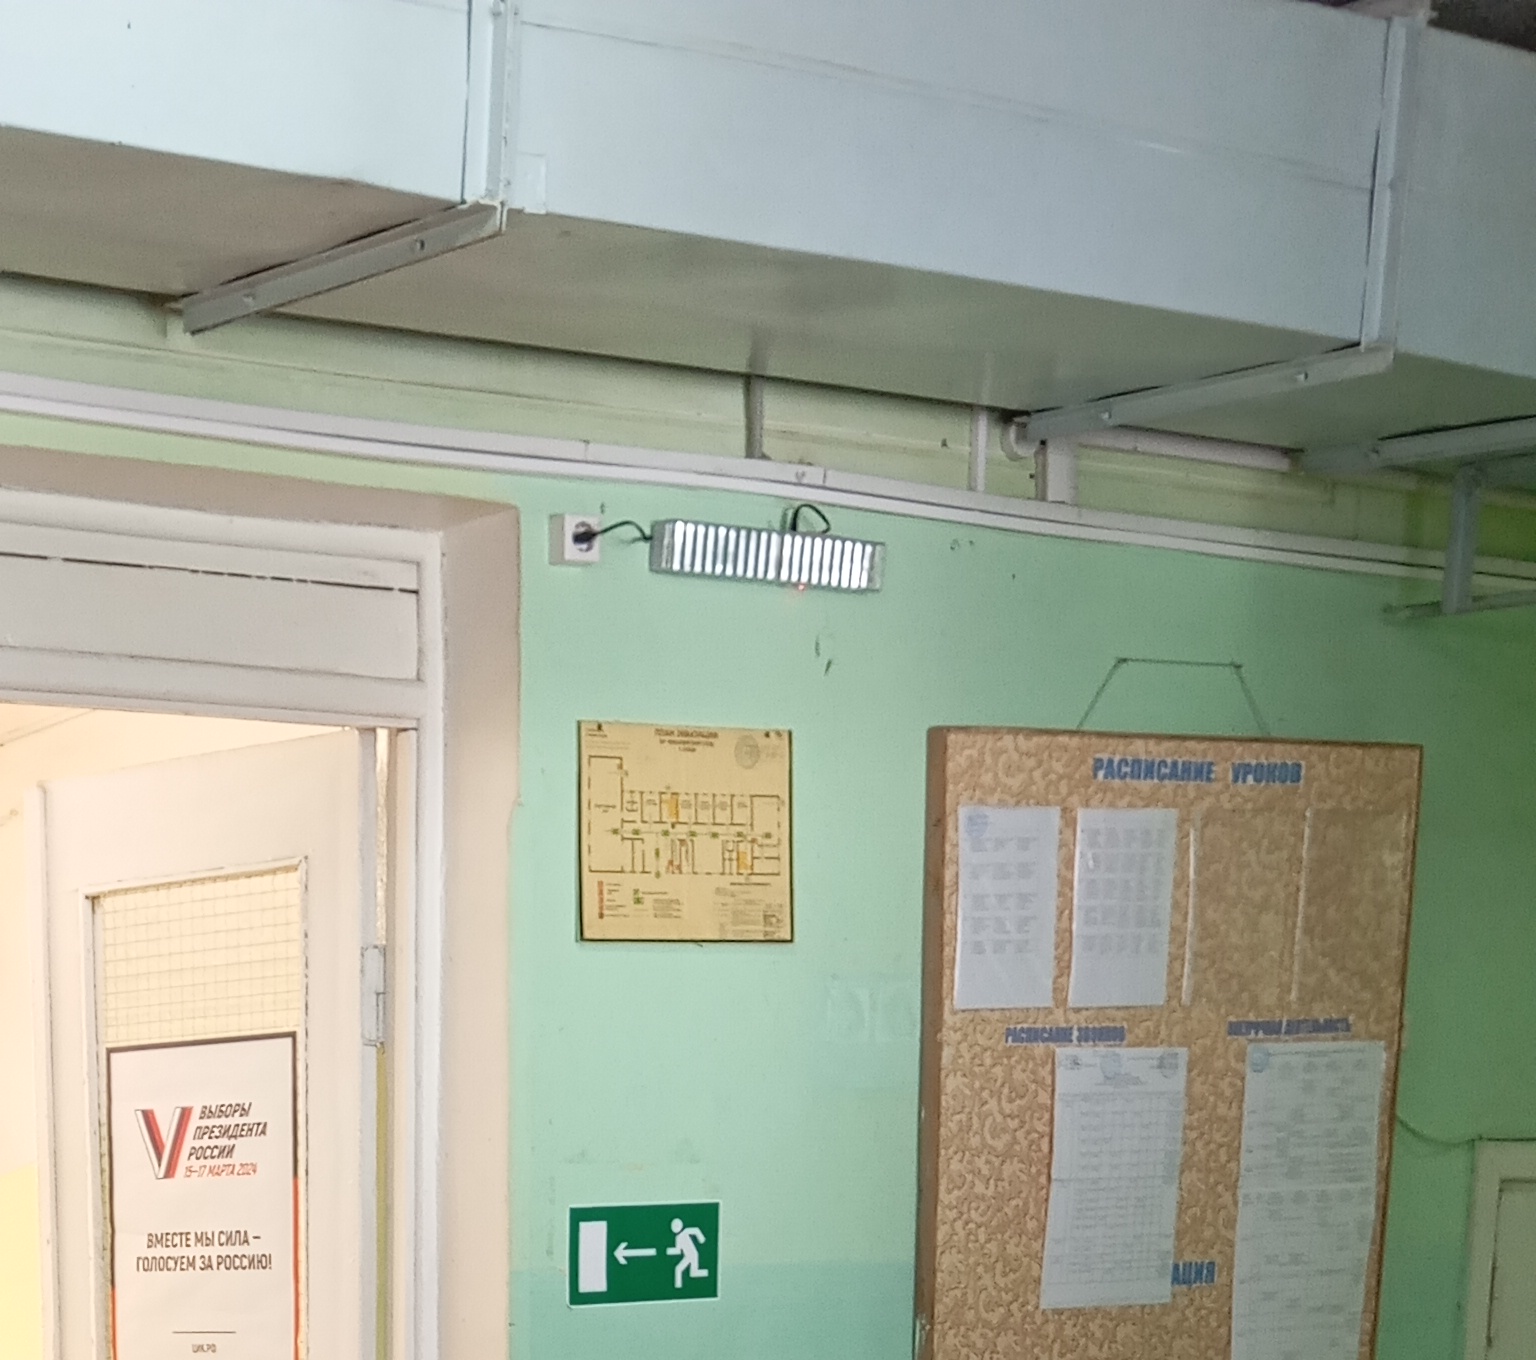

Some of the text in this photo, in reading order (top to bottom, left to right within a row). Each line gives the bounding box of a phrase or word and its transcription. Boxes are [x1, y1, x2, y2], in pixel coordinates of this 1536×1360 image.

[1093, 757, 1303, 785] РАСПИСАНИЕ УРОКОВ
[199, 1102, 252, 1120] ВЫБОРЫ
[193, 1122, 267, 1141] ПРЕЗИДЕНТА
[187, 1144, 236, 1161] РОССИИ
[208, 1163, 236, 1177] МАРТА
[236, 1162, 258, 1176] 2024
[147, 1231, 191, 1249] ВМЕСТЕ
[194, 1230, 214, 1247] МЫ
[217, 1230, 250, 1247] СИЛА
[136, 1253, 272, 1272] ГОЛОСУЕМ ЗА РОССИЮ!
